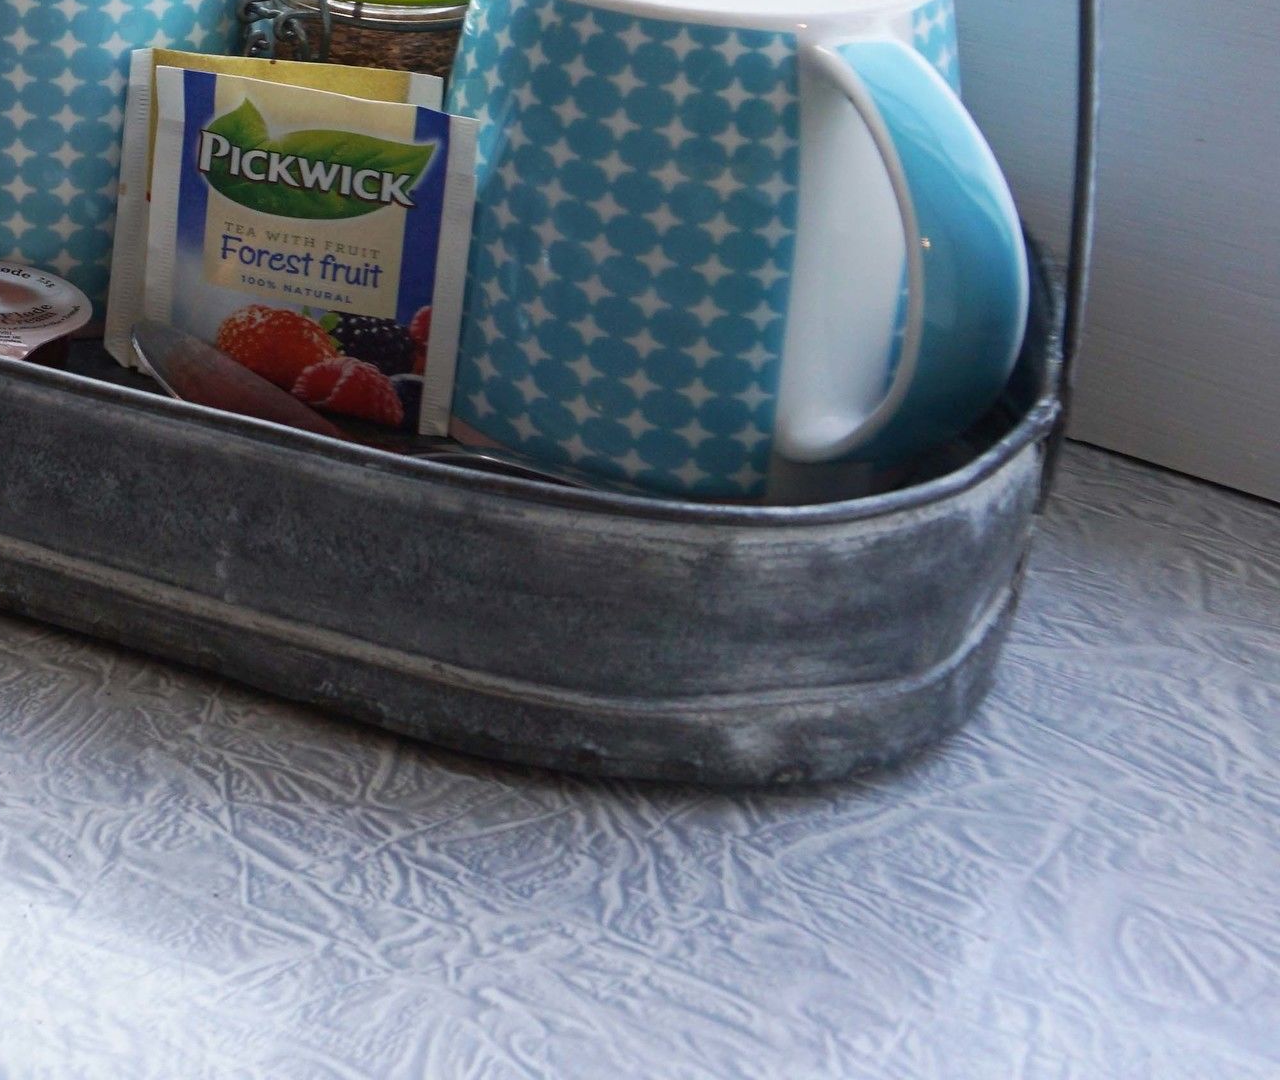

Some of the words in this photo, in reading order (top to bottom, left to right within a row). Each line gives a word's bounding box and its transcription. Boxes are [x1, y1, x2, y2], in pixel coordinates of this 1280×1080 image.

[198, 130, 415, 208] PICKWICK
[221, 234, 313, 277] Forest
[319, 254, 384, 288] fruit
[224, 221, 256, 238] TEA
[266, 230, 316, 248] WITH
[325, 240, 381, 259] FRUIT
[241, 274, 276, 290] 100%
[284, 284, 352, 305] NATURAL
